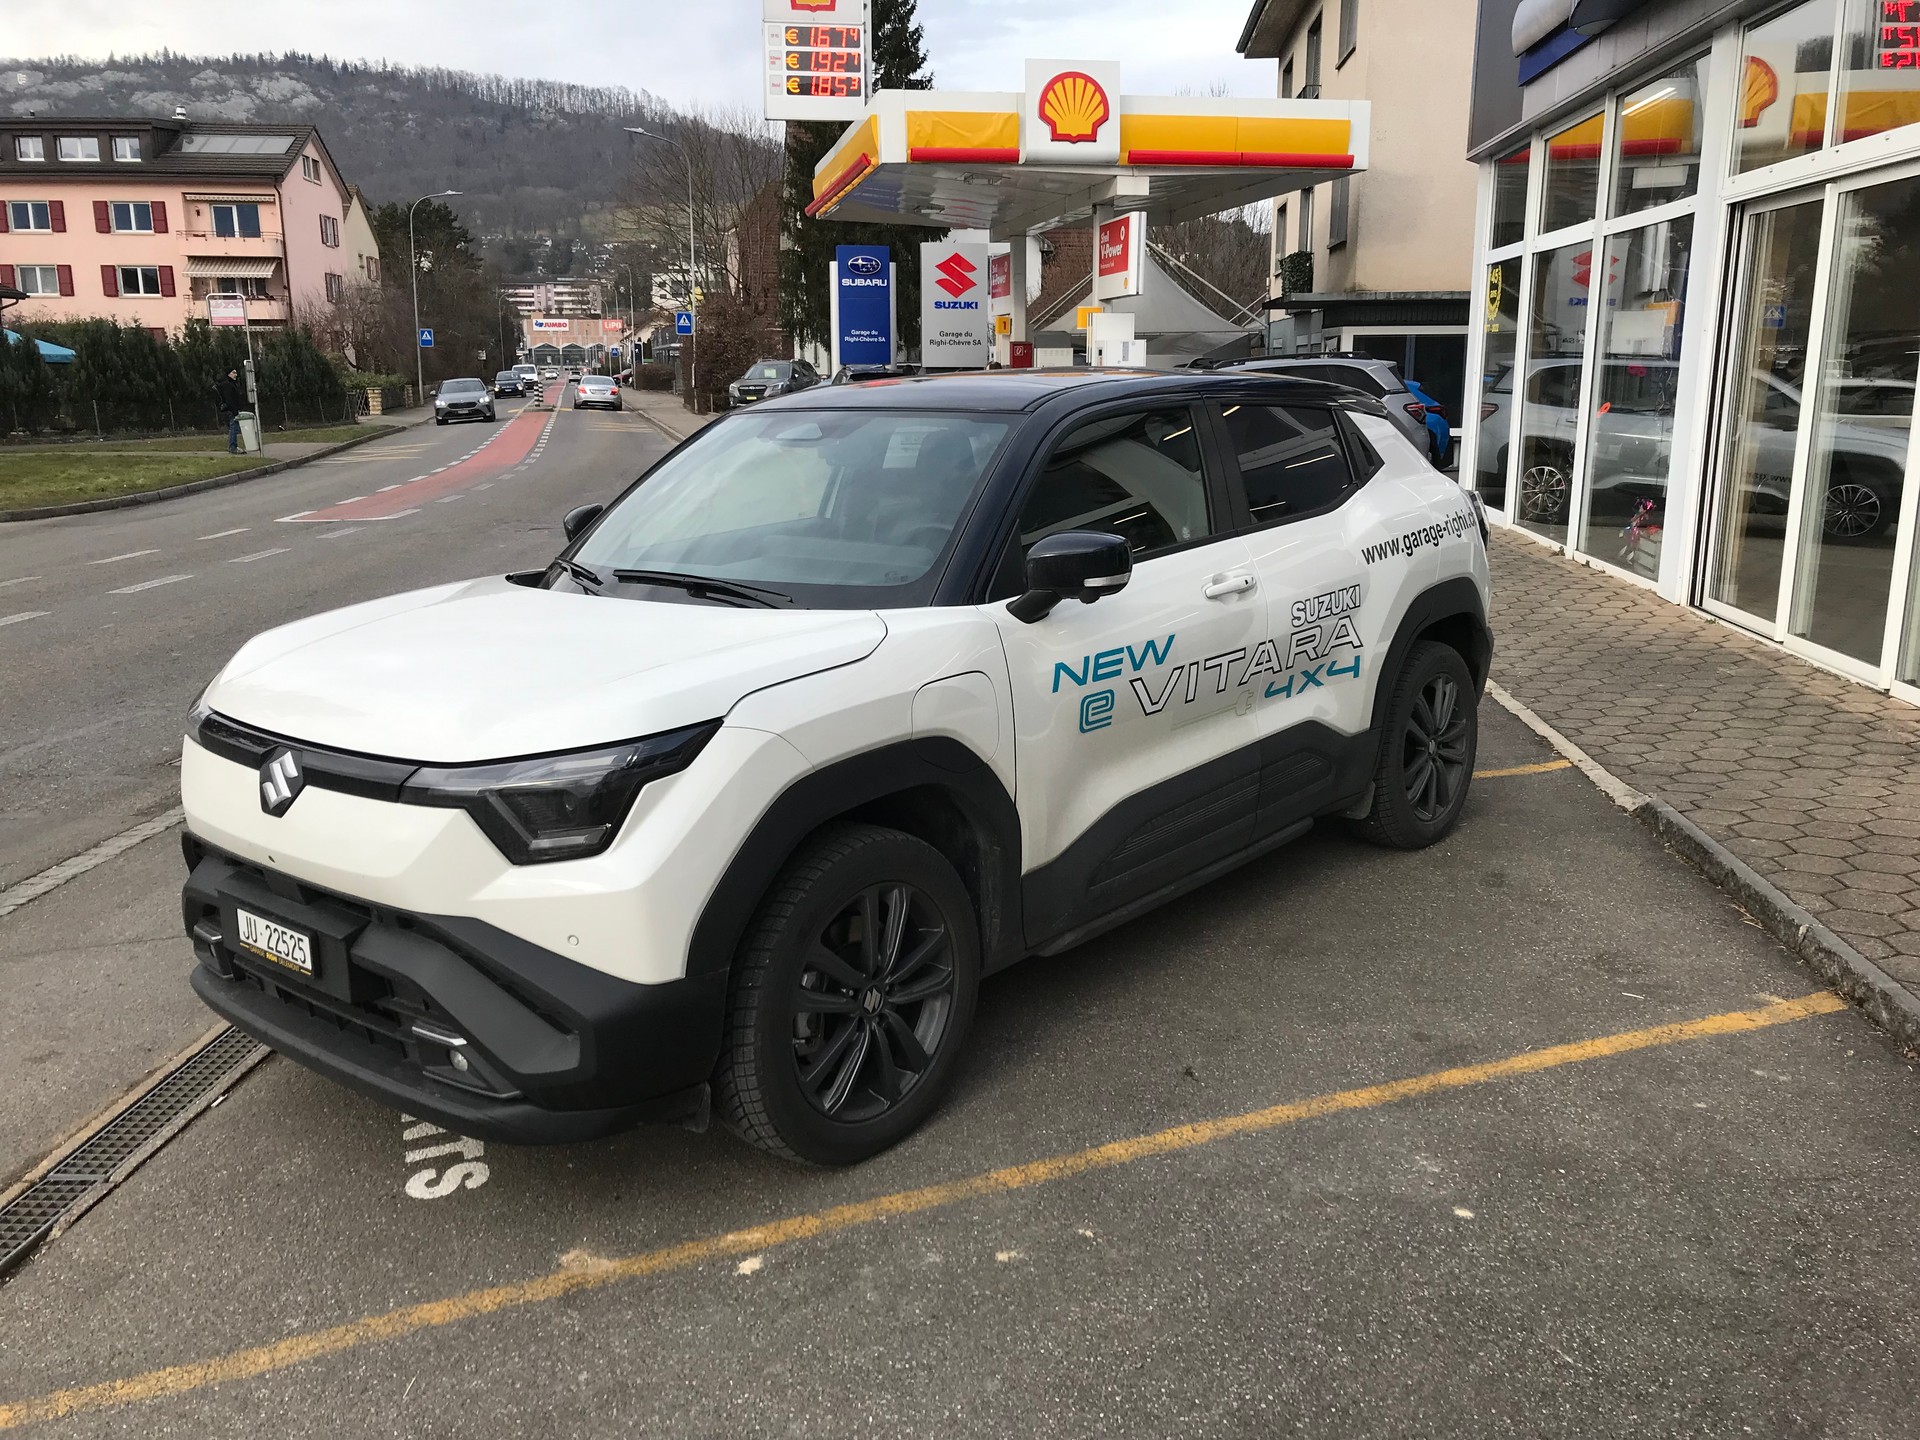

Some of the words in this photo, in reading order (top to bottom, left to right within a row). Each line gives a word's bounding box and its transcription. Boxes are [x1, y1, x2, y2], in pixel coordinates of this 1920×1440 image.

[1101, 243, 1123, 259] V-Power
[841, 278, 888, 287] SUBARU
[934, 301, 979, 310] SUZUKI
[850, 329, 871, 338] Garage
[939, 331, 963, 339] Garage
[929, 339, 971, 347] Righi-Chèvre
[1291, 584, 1361, 628] SUZUKI
[1052, 634, 1176, 694] NEW
[1129, 616, 1363, 717] VITARA
[243, 916, 258, 943] JU
[265, 924, 306, 964] 22525
